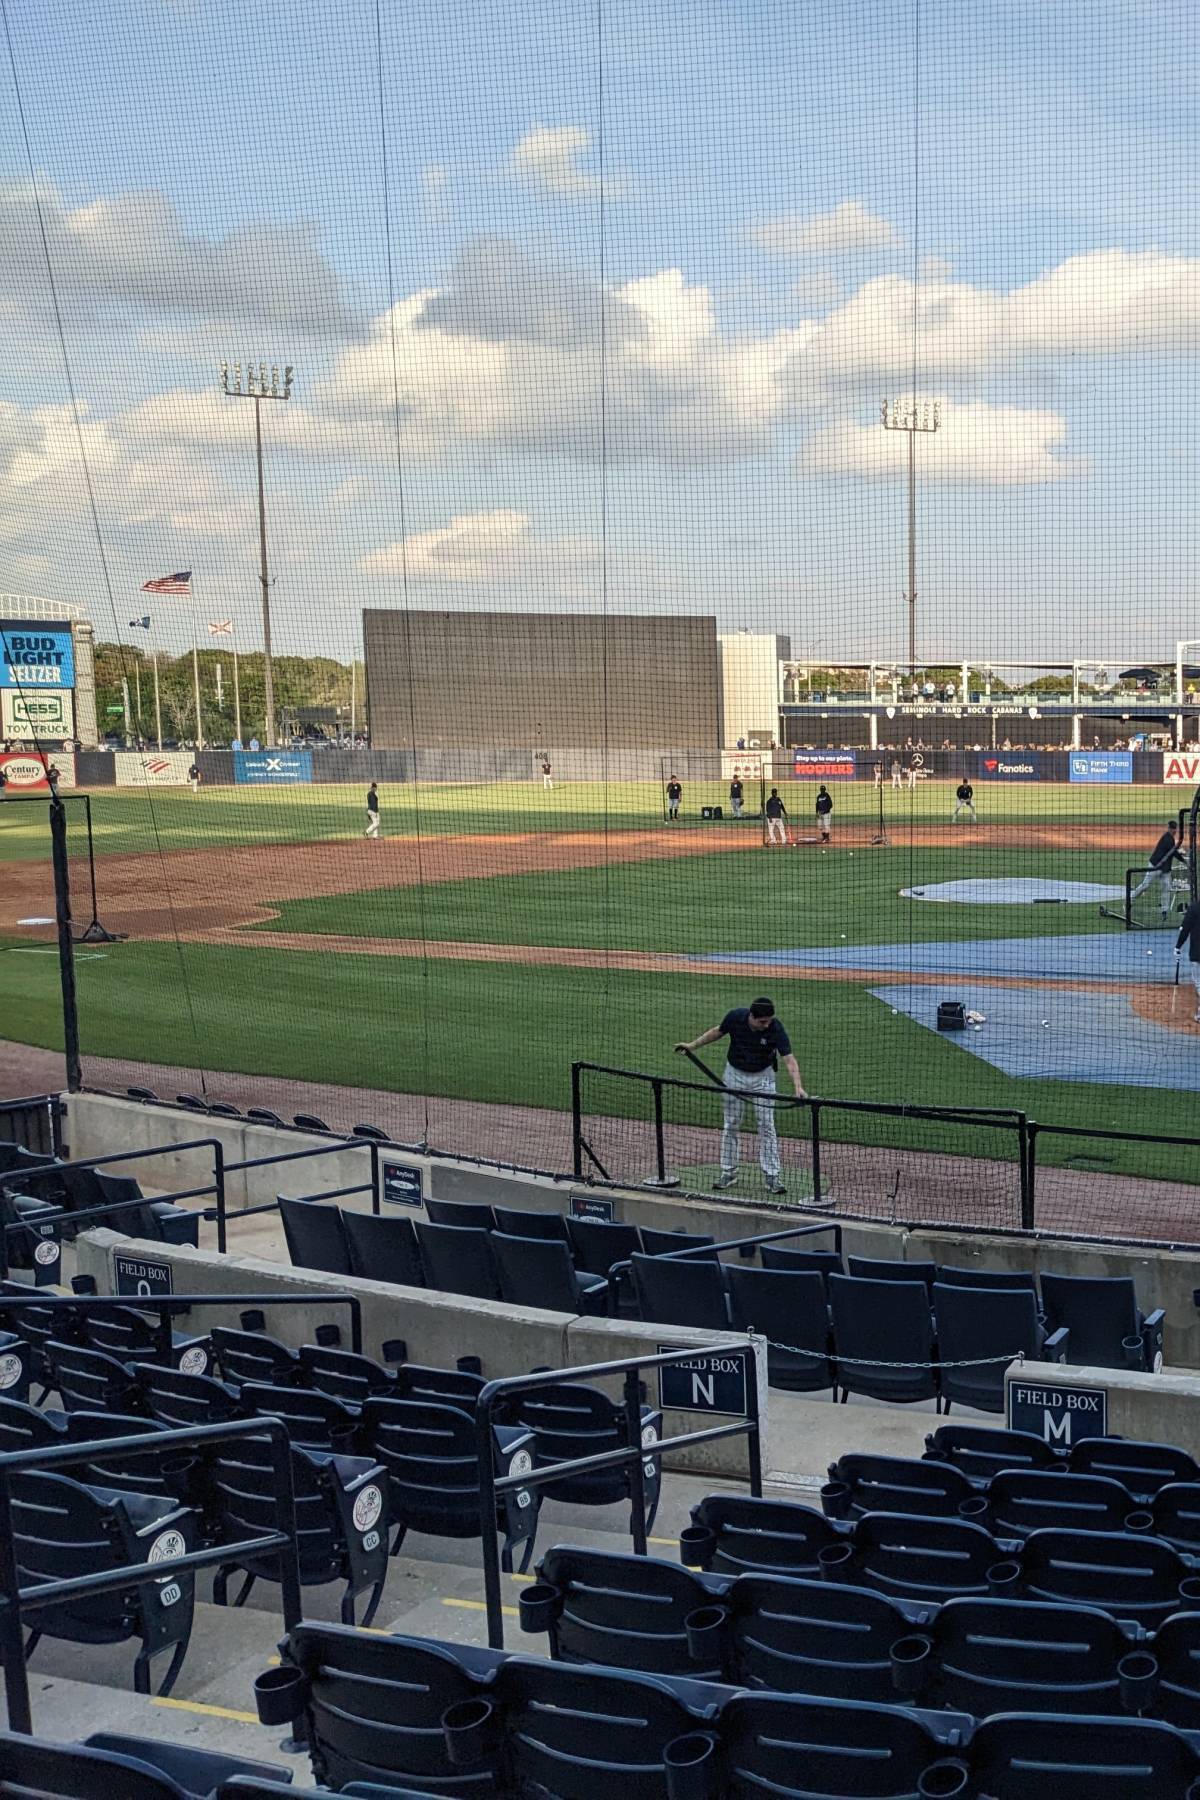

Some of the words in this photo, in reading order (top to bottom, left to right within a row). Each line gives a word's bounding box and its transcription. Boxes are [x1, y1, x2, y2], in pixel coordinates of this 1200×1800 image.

[11, 637, 56, 651] BUD
[4, 651, 64, 665] LIGHT
[8, 665, 62, 683] SELTZER
[17, 703, 58, 714] HESS
[7, 725, 28, 734] TOY
[34, 725, 69, 734] TRUCK
[4, 764, 41, 777] Century
[795, 763, 854, 775] HOOTERS
[998, 763, 1034, 774] Fanatics
[119, 1262, 146, 1277] FIELD
[147, 1267, 167, 1282] BOX
[711, 1358, 740, 1374] BOX
[691, 1372, 715, 1406] N
[1016, 1389, 1063, 1407] FIELD
[1067, 1394, 1099, 1412] BOX
[1043, 1409, 1071, 1445] M
[366, 1534, 377, 1548] CC
[164, 1587, 178, 1603] DD
